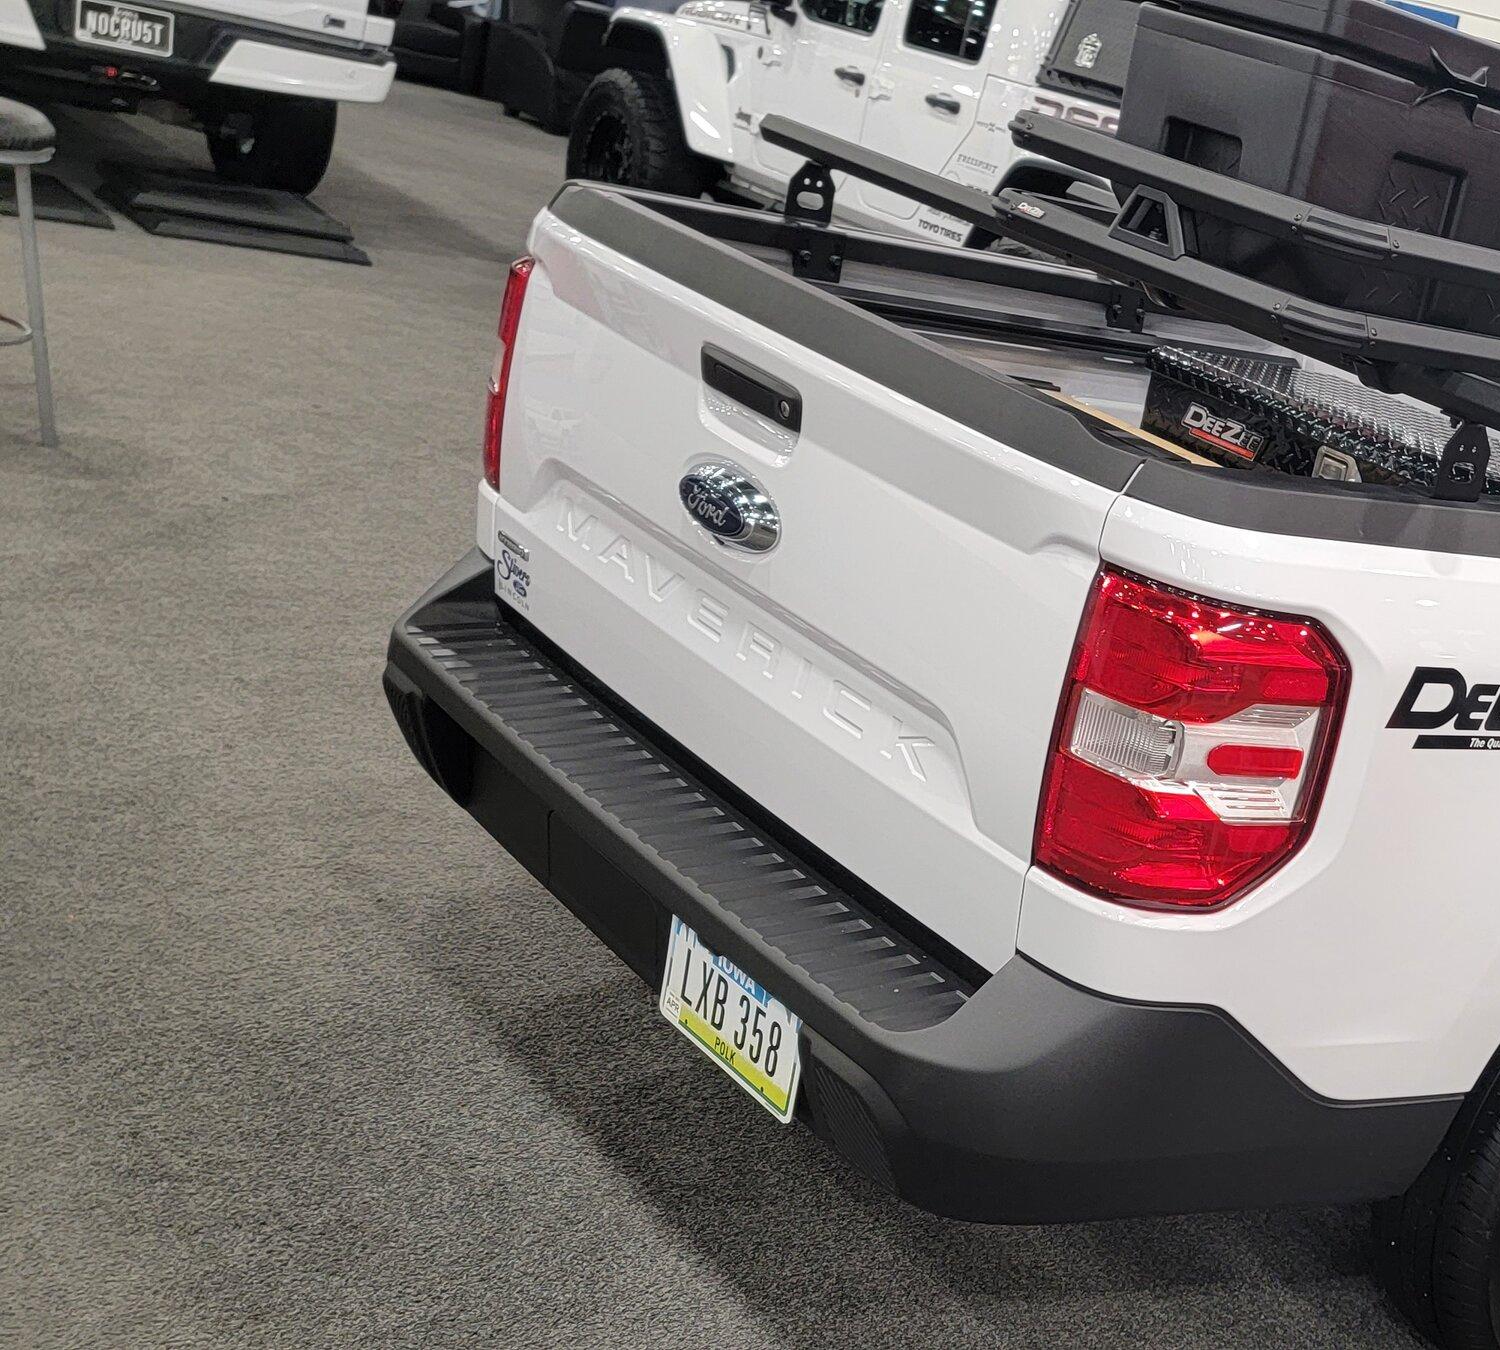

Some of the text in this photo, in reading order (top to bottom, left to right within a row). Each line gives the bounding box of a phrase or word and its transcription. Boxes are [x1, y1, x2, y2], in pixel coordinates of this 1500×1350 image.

[1183, 405, 1261, 448] DEEZEE
[688, 485, 731, 527] Ford
[556, 497, 936, 783] MAVERICK
[1469, 737, 1485, 749] The
[719, 956, 757, 996] IOWA
[665, 993, 680, 1015] APR
[681, 947, 783, 1078] LXB 358
[714, 1036, 737, 1066] POLK
